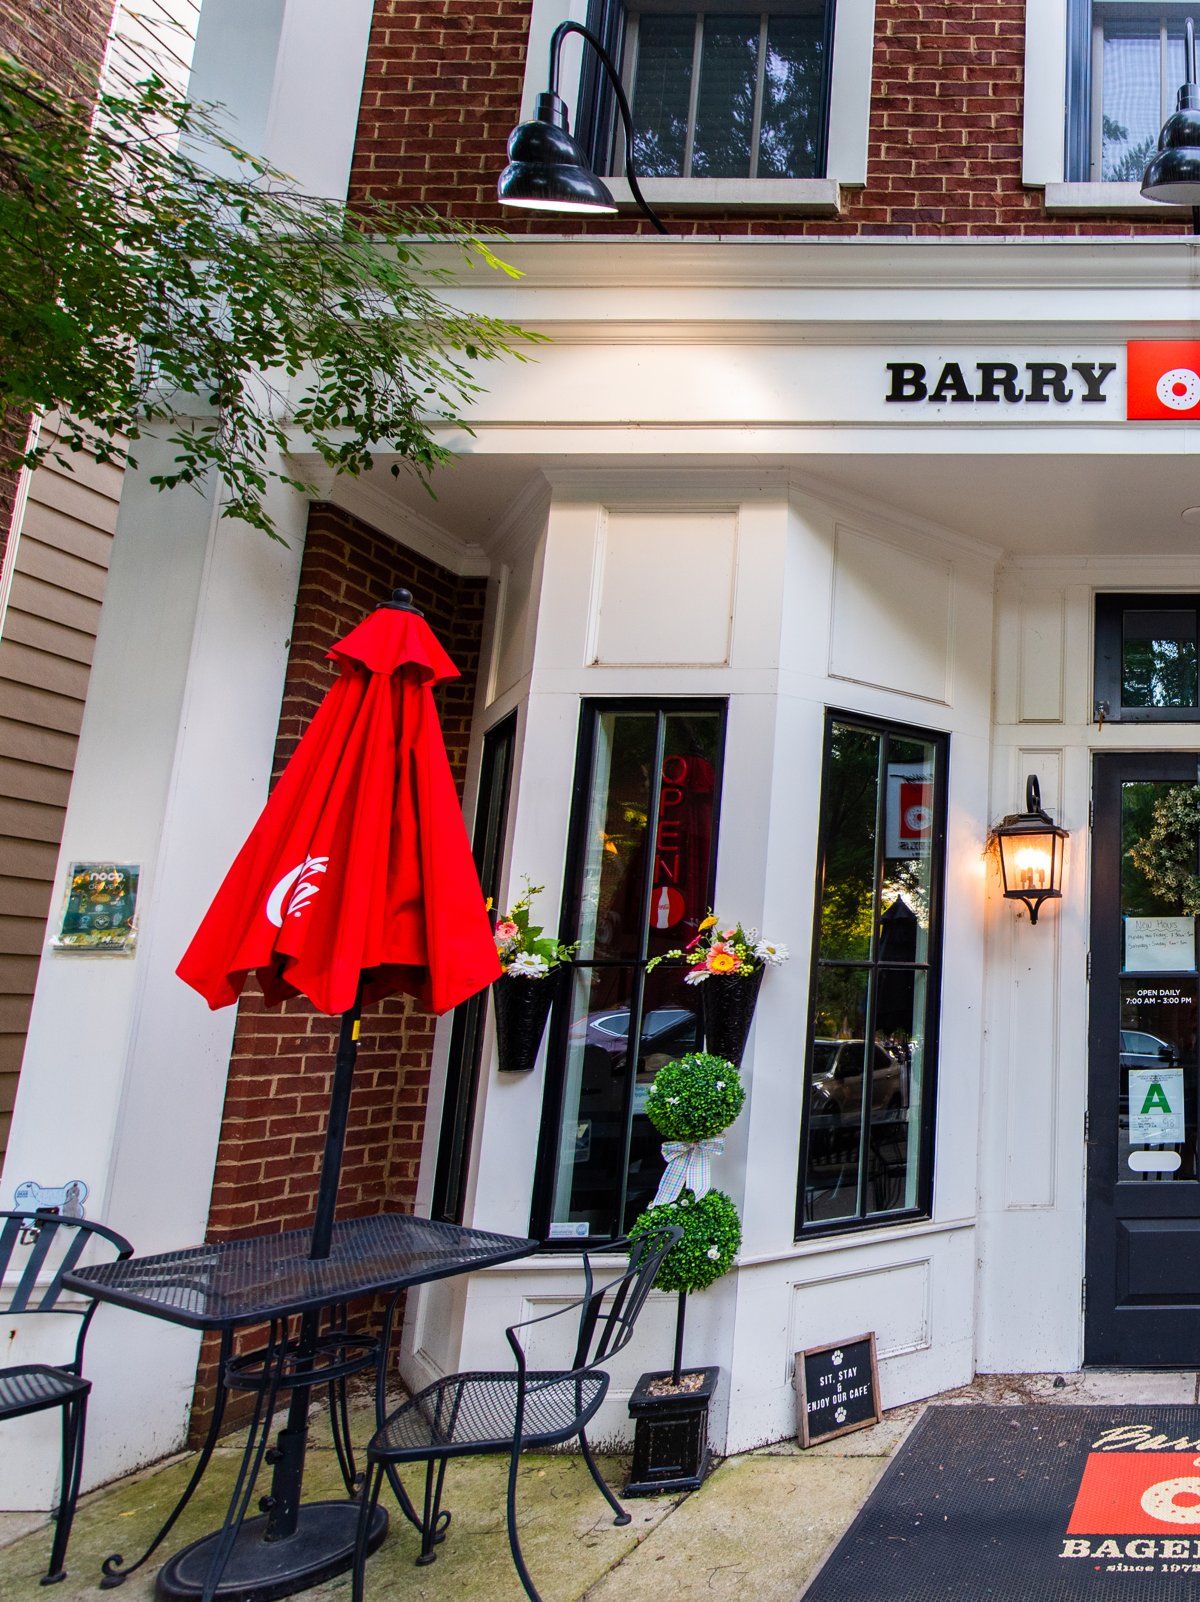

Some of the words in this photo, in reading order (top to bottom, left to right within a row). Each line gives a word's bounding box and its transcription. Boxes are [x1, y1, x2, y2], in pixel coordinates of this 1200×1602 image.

[885, 362, 1117, 403] BARRY
[653, 755, 687, 884] OPEN
[1140, 1083, 1172, 1114] A
[838, 1366, 858, 1381] STAY
[837, 1383, 842, 1392] &
[807, 1396, 830, 1413] ENJOY
[832, 1392, 847, 1404] OUR
[1105, 1563, 1154, 1572] since
